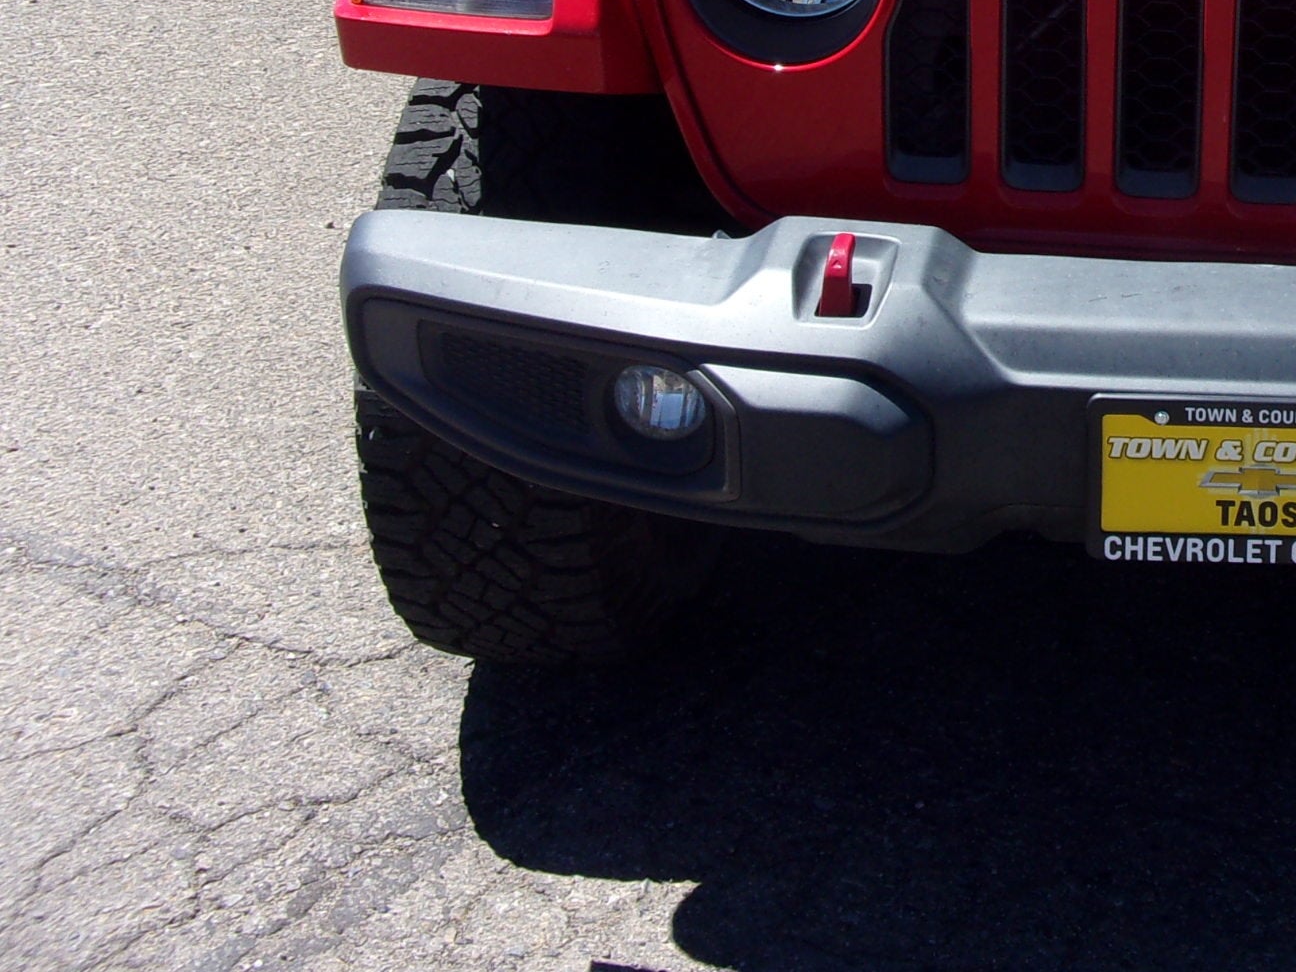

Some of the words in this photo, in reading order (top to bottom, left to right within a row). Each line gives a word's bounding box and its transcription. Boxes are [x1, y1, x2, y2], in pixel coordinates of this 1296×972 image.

[1185, 407, 1236, 422] TOWN
[1242, 409, 1253, 423] &
[1108, 437, 1208, 460] TOWN
[1215, 439, 1243, 461] &
[1103, 535, 1283, 562] CHEVROLET
